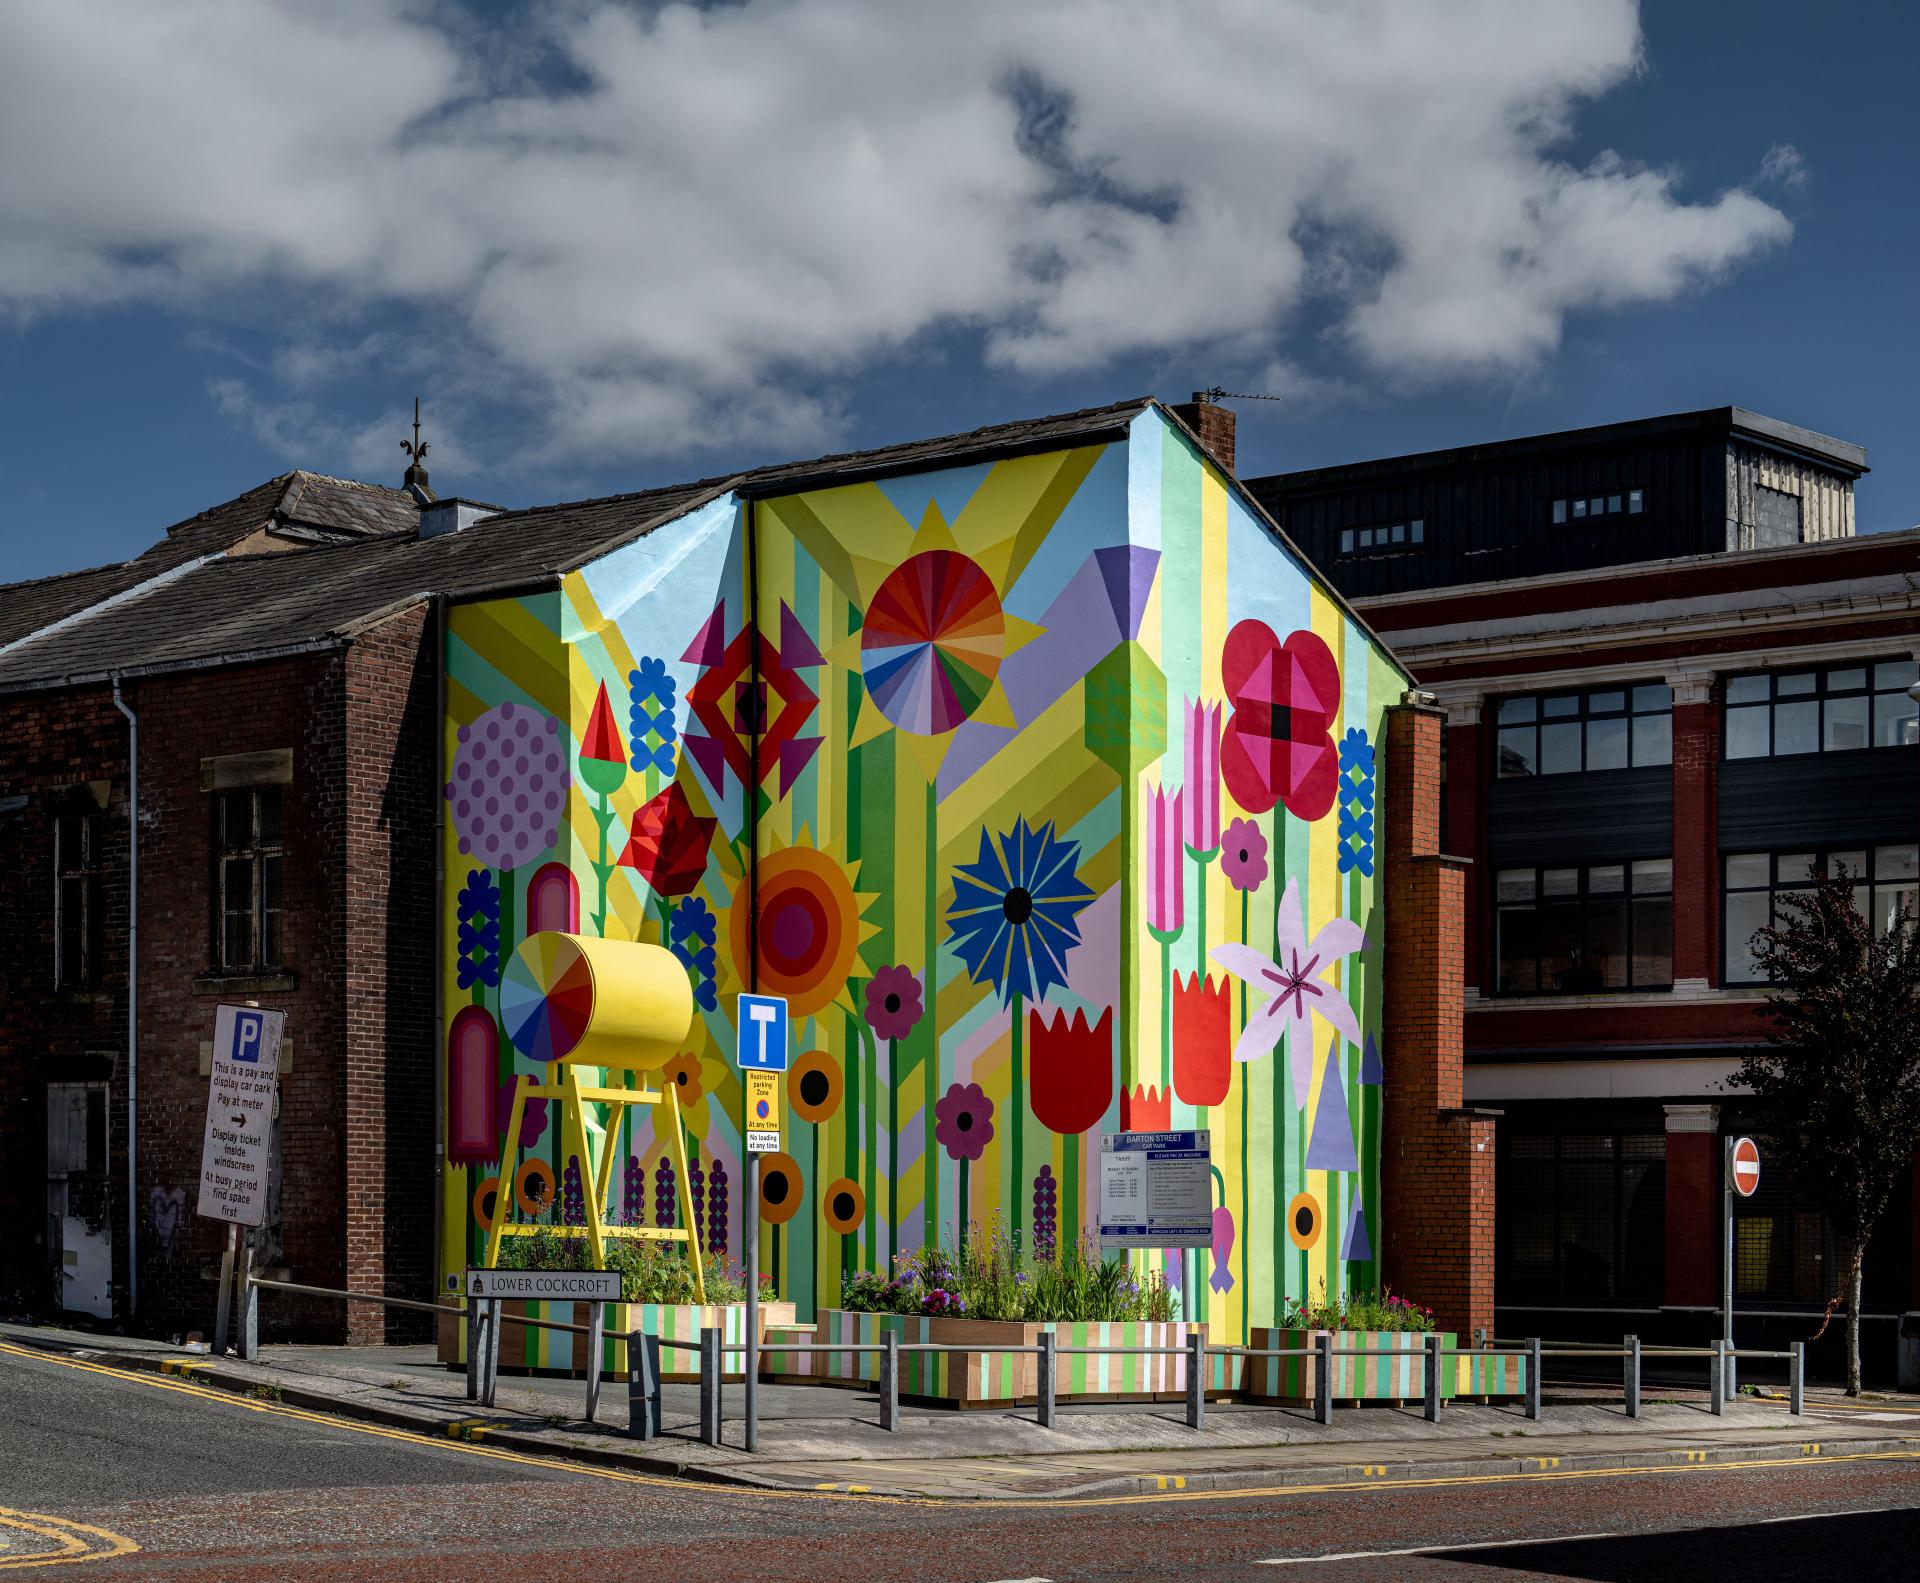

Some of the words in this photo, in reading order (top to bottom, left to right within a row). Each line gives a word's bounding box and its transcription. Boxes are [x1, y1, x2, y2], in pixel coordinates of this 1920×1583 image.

[238, 1018, 258, 1056] P
[214, 1061, 229, 1074] This
[230, 1064, 237, 1075] is
[239, 1068, 243, 1076] a
[245, 1068, 258, 1080] pay
[260, 1070, 274, 1081] and
[750, 1073, 776, 1081] Restricted
[213, 1076, 239, 1091] display
[240, 1081, 252, 1090] car
[254, 1083, 271, 1095] park
[753, 1081, 773, 1089] parking
[217, 1093, 231, 1107] Pay
[232, 1096, 240, 1106] at
[242, 1098, 263, 1110] meter
[766, 1121, 778, 1129] time
[212, 1128, 238, 1144] Display
[240, 1133, 261, 1146] ticket
[758, 1134, 777, 1142] loading
[1126, 1135, 1154, 1143] BARTON
[1155, 1134, 1182, 1142] STREET
[224, 1143, 246, 1157] inside
[756, 1142, 766, 1150] any
[214, 1156, 255, 1172] windscreen
[205, 1171, 213, 1182] At
[215, 1173, 232, 1188] busy
[234, 1179, 258, 1191] period
[213, 1187, 227, 1200] find
[228, 1193, 250, 1204] space
[221, 1204, 237, 1217] first
[492, 1277, 532, 1292] LOWER
[536, 1278, 610, 1293] COCKCROFT
